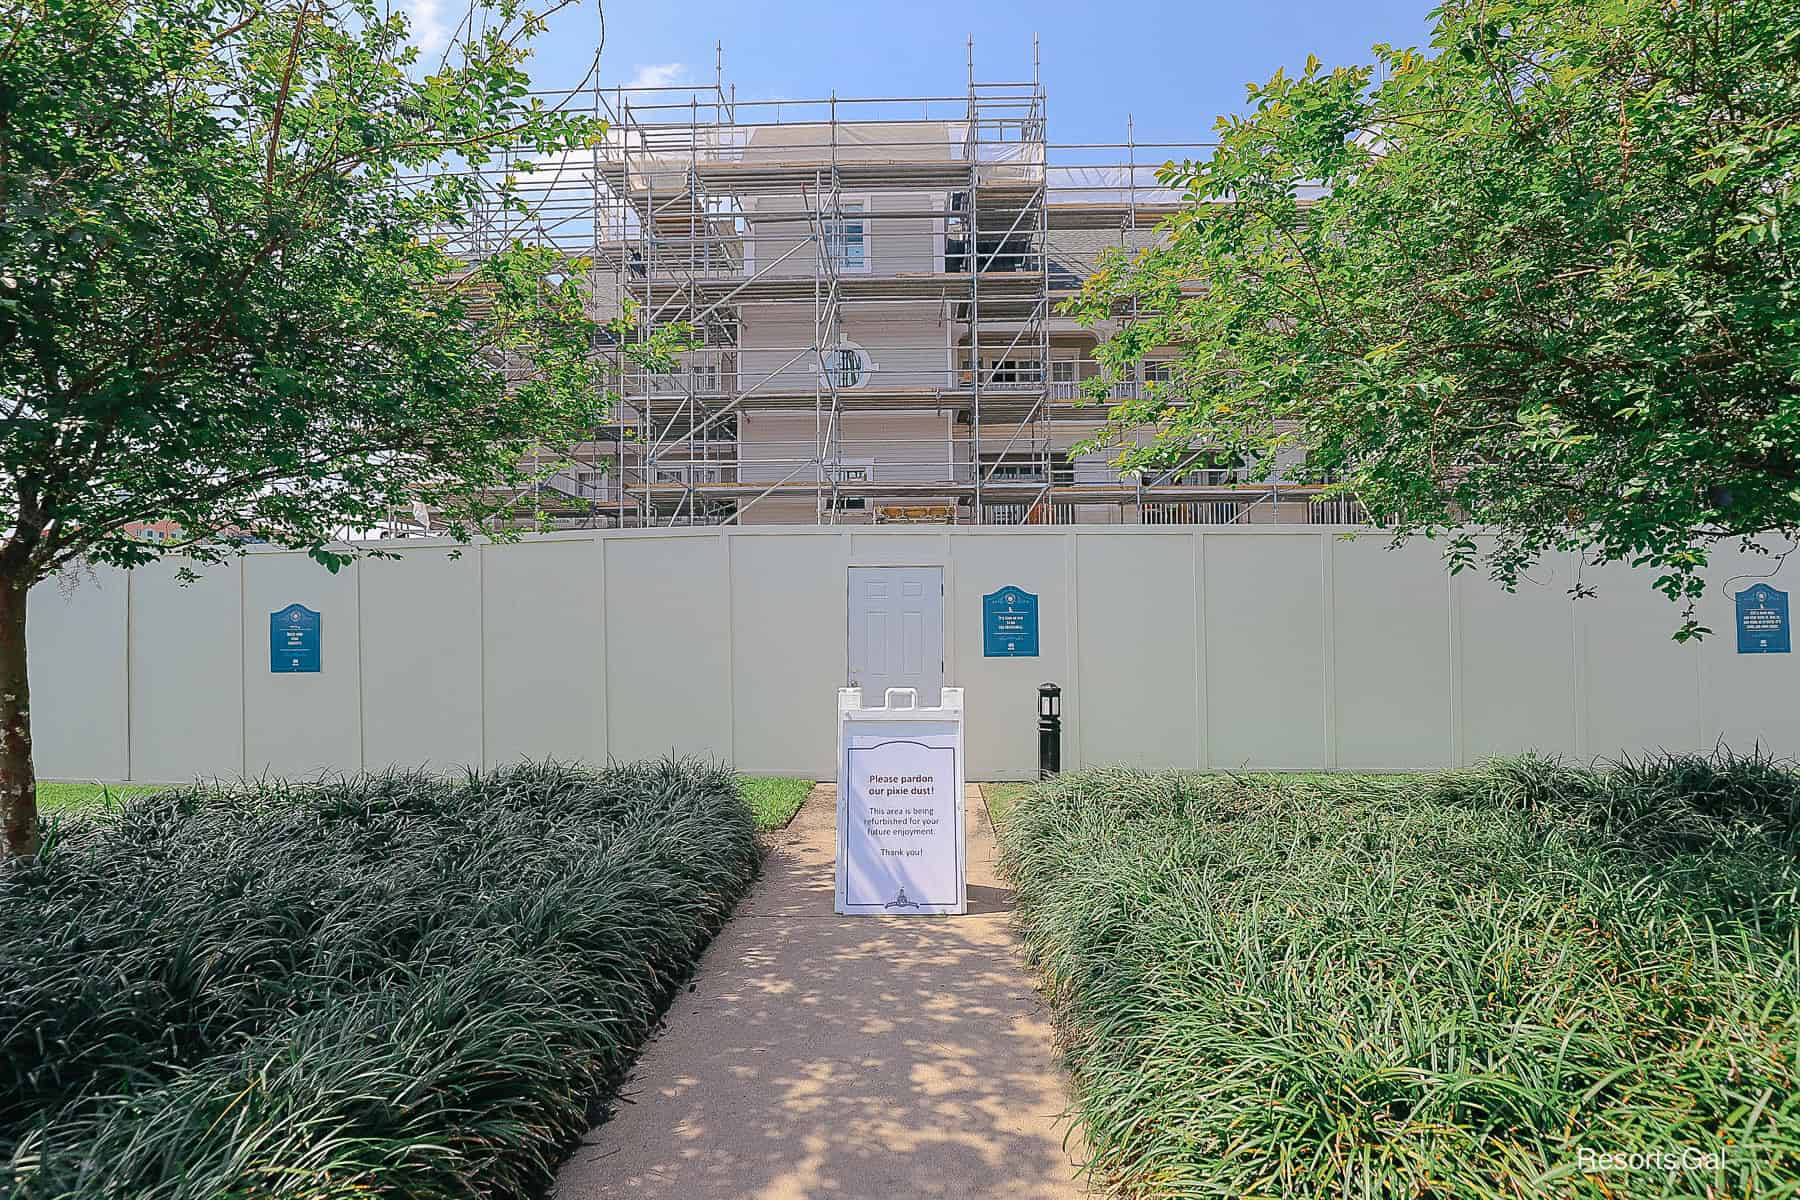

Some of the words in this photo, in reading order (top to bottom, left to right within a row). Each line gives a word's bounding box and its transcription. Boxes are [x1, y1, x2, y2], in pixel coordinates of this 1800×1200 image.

[869, 775, 899, 784] Please
[901, 775, 934, 785] pardon
[868, 787, 885, 796] our
[887, 786, 909, 797] pixie
[910, 786, 935, 796] dust!
[869, 807, 885, 815] This
[913, 807, 934, 816] being
[864, 817, 908, 825] refurbished
[909, 817, 921, 825] for
[867, 827, 891, 836] future
[880, 848, 904, 856] Thank
[905, 848, 923, 857] you!
